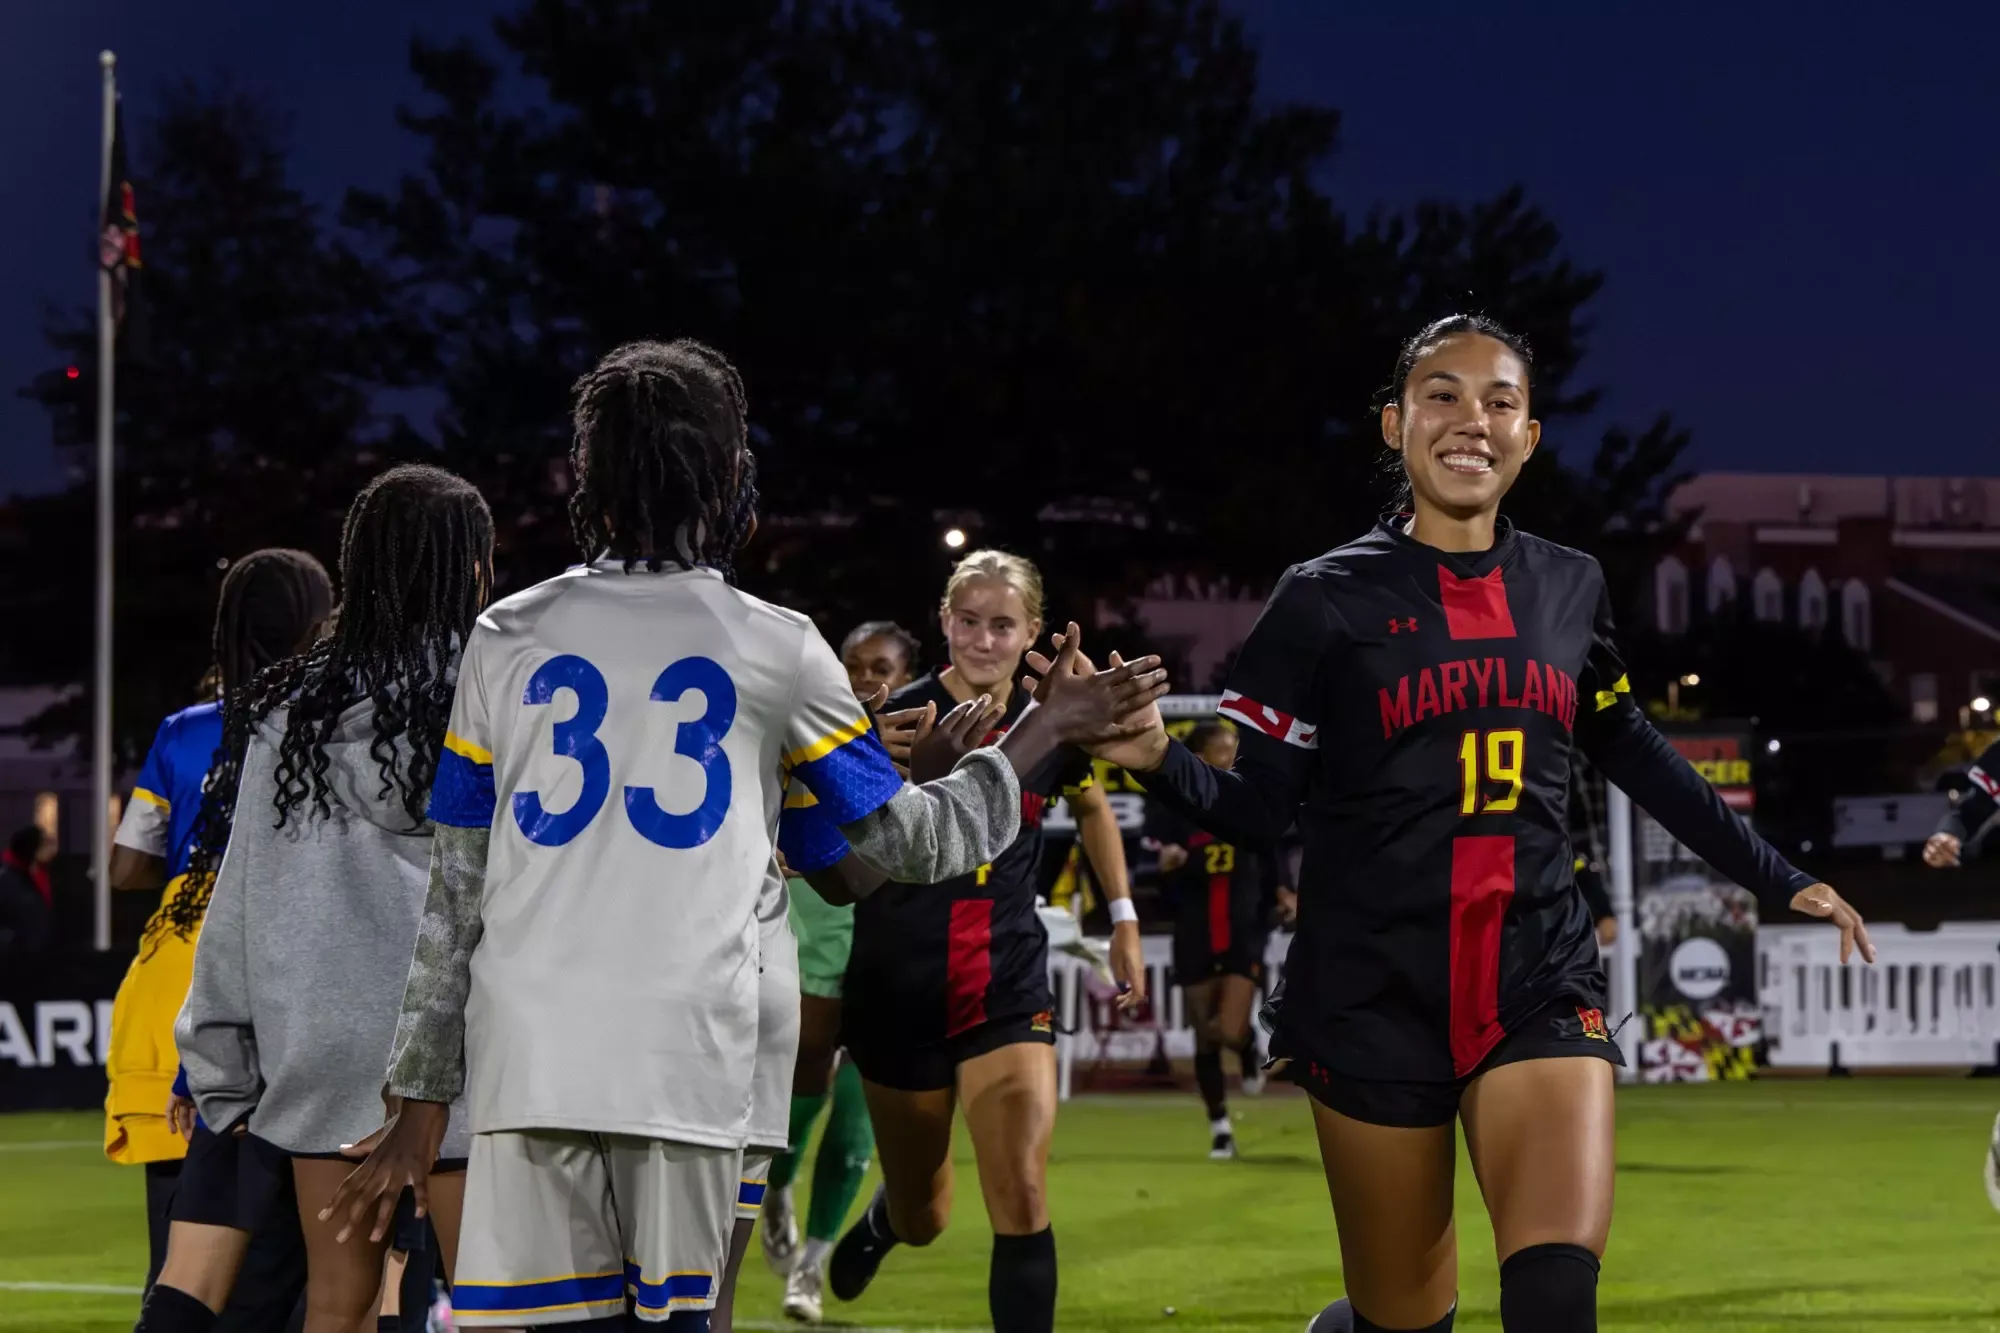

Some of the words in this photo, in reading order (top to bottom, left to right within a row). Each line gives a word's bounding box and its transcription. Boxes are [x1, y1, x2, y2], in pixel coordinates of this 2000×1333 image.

[512, 653, 738, 850] 33
[1457, 727, 1526, 817] 19
[1203, 843, 1236, 874] 23
